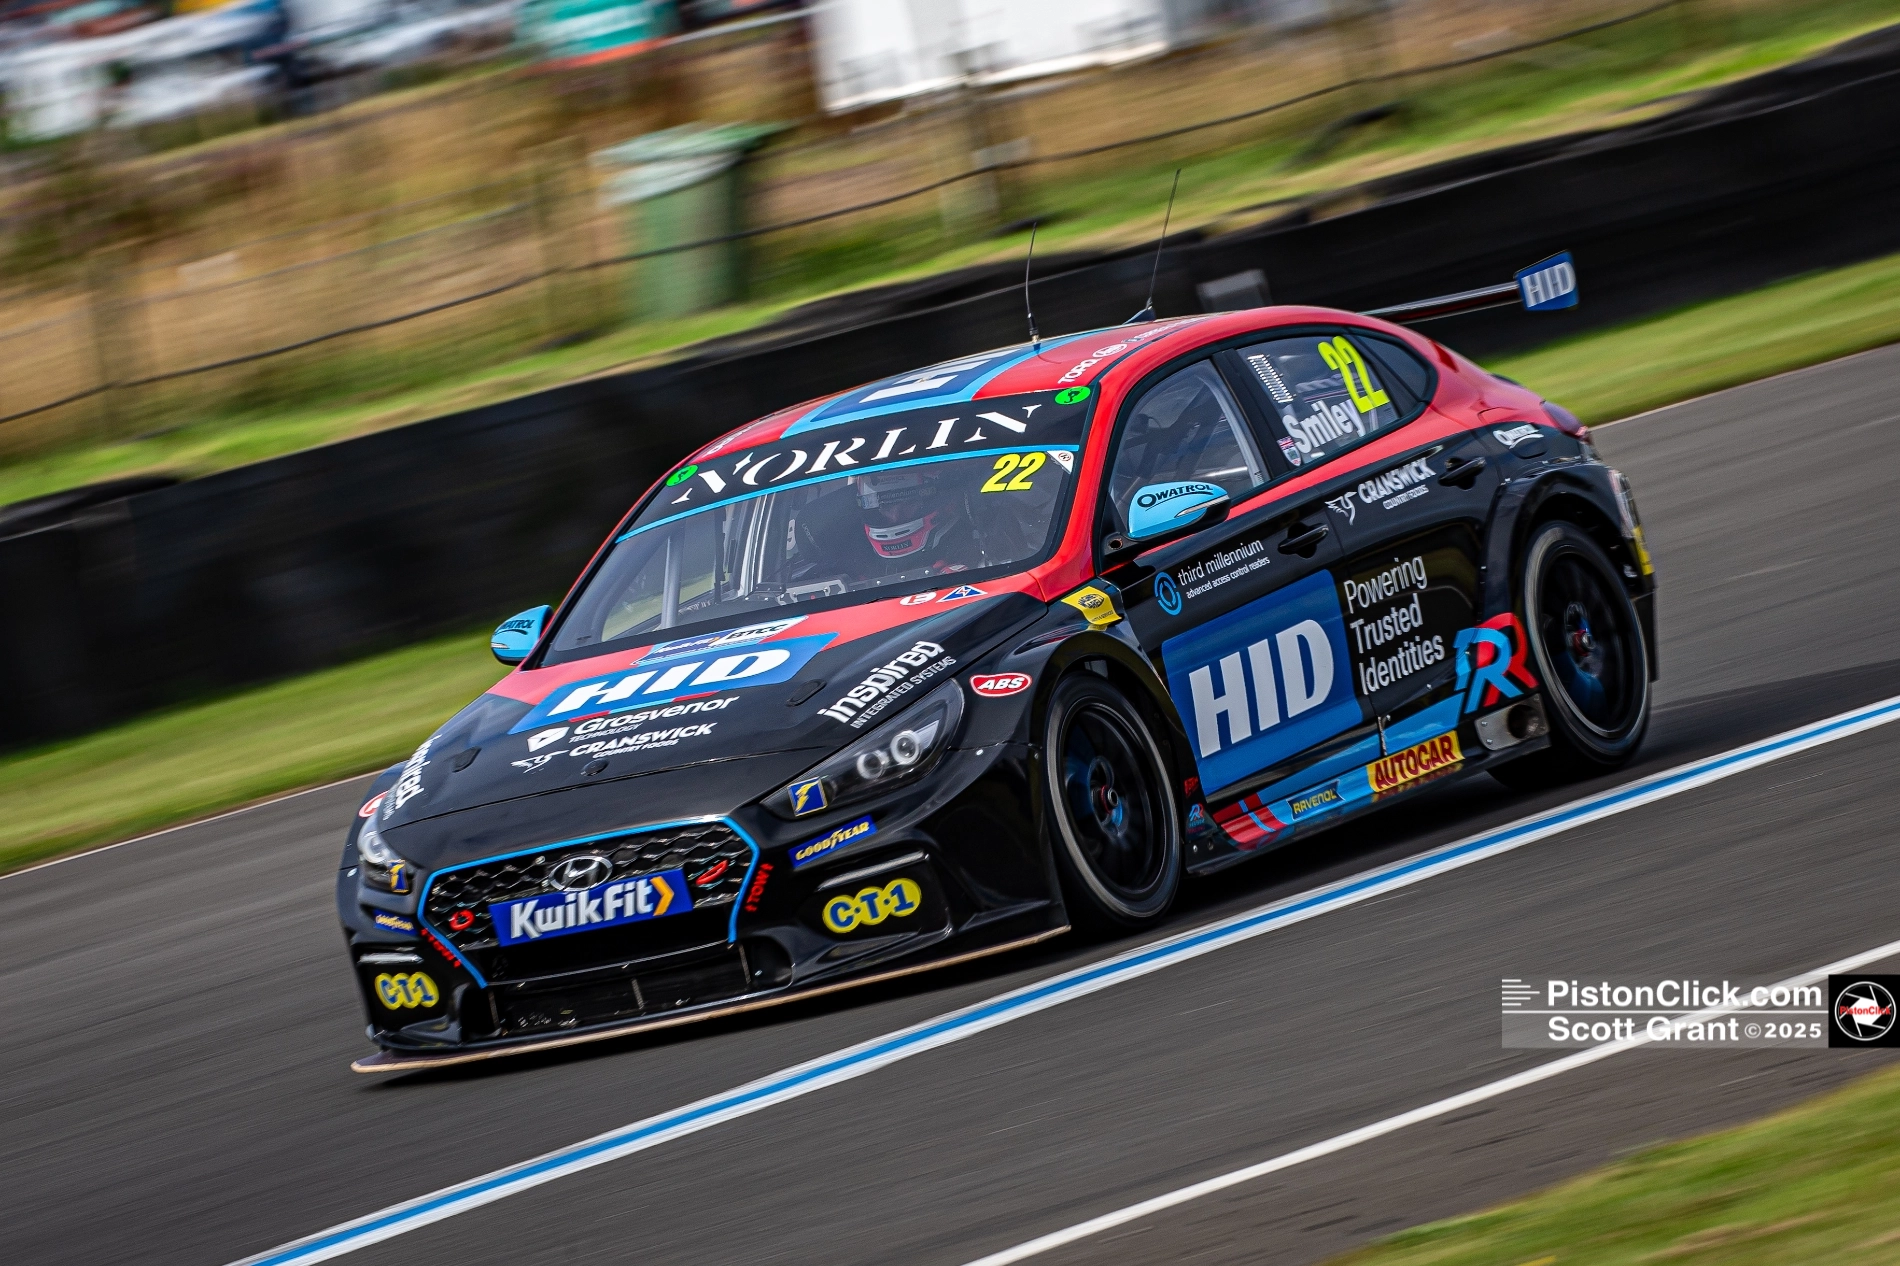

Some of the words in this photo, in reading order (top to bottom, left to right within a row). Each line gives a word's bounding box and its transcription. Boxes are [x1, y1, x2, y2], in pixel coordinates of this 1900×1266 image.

[1521, 261, 1576, 308] HID
[1317, 335, 1391, 413] 22
[1282, 399, 1367, 453] Smiley
[671, 403, 1042, 505] NORLIN
[980, 451, 1047, 494] 22
[1137, 484, 1214, 508] OWATROL
[1357, 457, 1437, 504] CRANSWICK
[883, 540, 909, 551] NORLIN
[1177, 561, 1206, 586] third
[1205, 540, 1265, 575] millennium
[1186, 580, 1213, 599] advanced
[1211, 574, 1231, 590] access
[1229, 564, 1250, 579] control
[1248, 556, 1271, 571] readers
[1343, 555, 1428, 614] Powering
[1350, 592, 1424, 654] Trusted
[547, 648, 791, 717] HID
[816, 640, 945, 724] inspired
[976, 676, 1026, 690] ABS
[1188, 618, 1335, 759] HID
[1358, 635, 1446, 696] Identities
[573, 696, 740, 735] Grosvenor
[849, 681, 915, 729] INTEGRATED
[909, 655, 957, 686] SYSTEMS
[568, 722, 643, 744] TECHNOLOGY
[568, 722, 719, 758] CRANSWICK
[592, 743, 642, 760] COUNTRY
[641, 738, 680, 751] FOODS
[1374, 735, 1456, 790] AUTOCAR
[1292, 788, 1337, 815] RAVENOL
[794, 821, 870, 861] GOODYEAR
